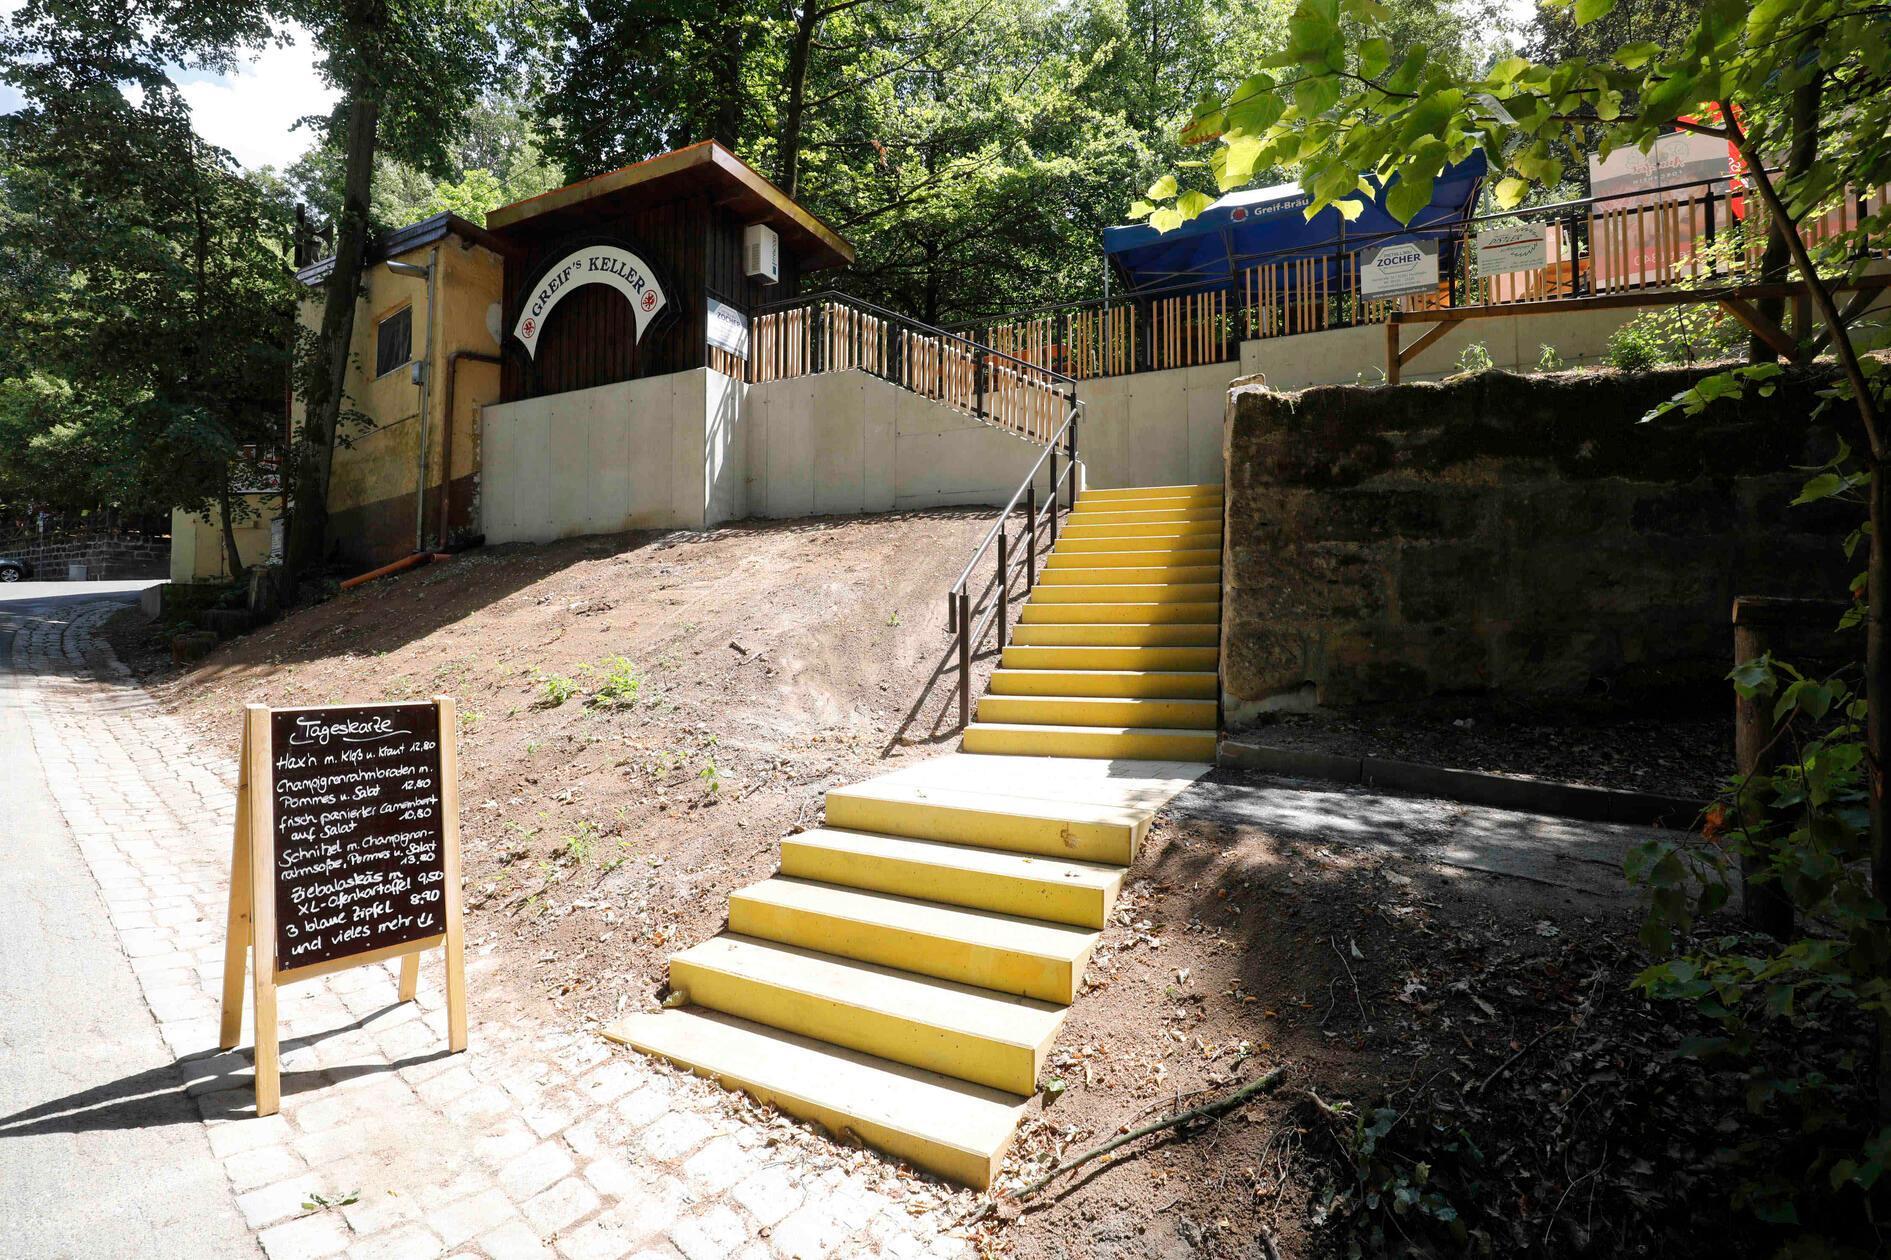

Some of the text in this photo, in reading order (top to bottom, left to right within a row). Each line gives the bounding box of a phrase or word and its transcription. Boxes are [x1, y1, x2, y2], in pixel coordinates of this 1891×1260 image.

[1254, 199, 1309, 216] Greif-Bräu
[1377, 253, 1421, 268] ZOCHER
[587, 256, 646, 295] KELLER
[276, 752, 318, 770] Hax'n
[324, 755, 338, 765] m.
[378, 742, 405, 758] Kraut
[279, 795, 336, 809] Pommes
[279, 813, 318, 834] frisch
[290, 826, 316, 842] auf
[319, 820, 358, 839] Salat
[278, 839, 343, 868] Schnitzel
[346, 842, 360, 852] m.
[405, 840, 438, 855] Salat
[285, 924, 299, 938] 3
[304, 912, 347, 932] blaue
[291, 914, 414, 956] und vieles mehr
